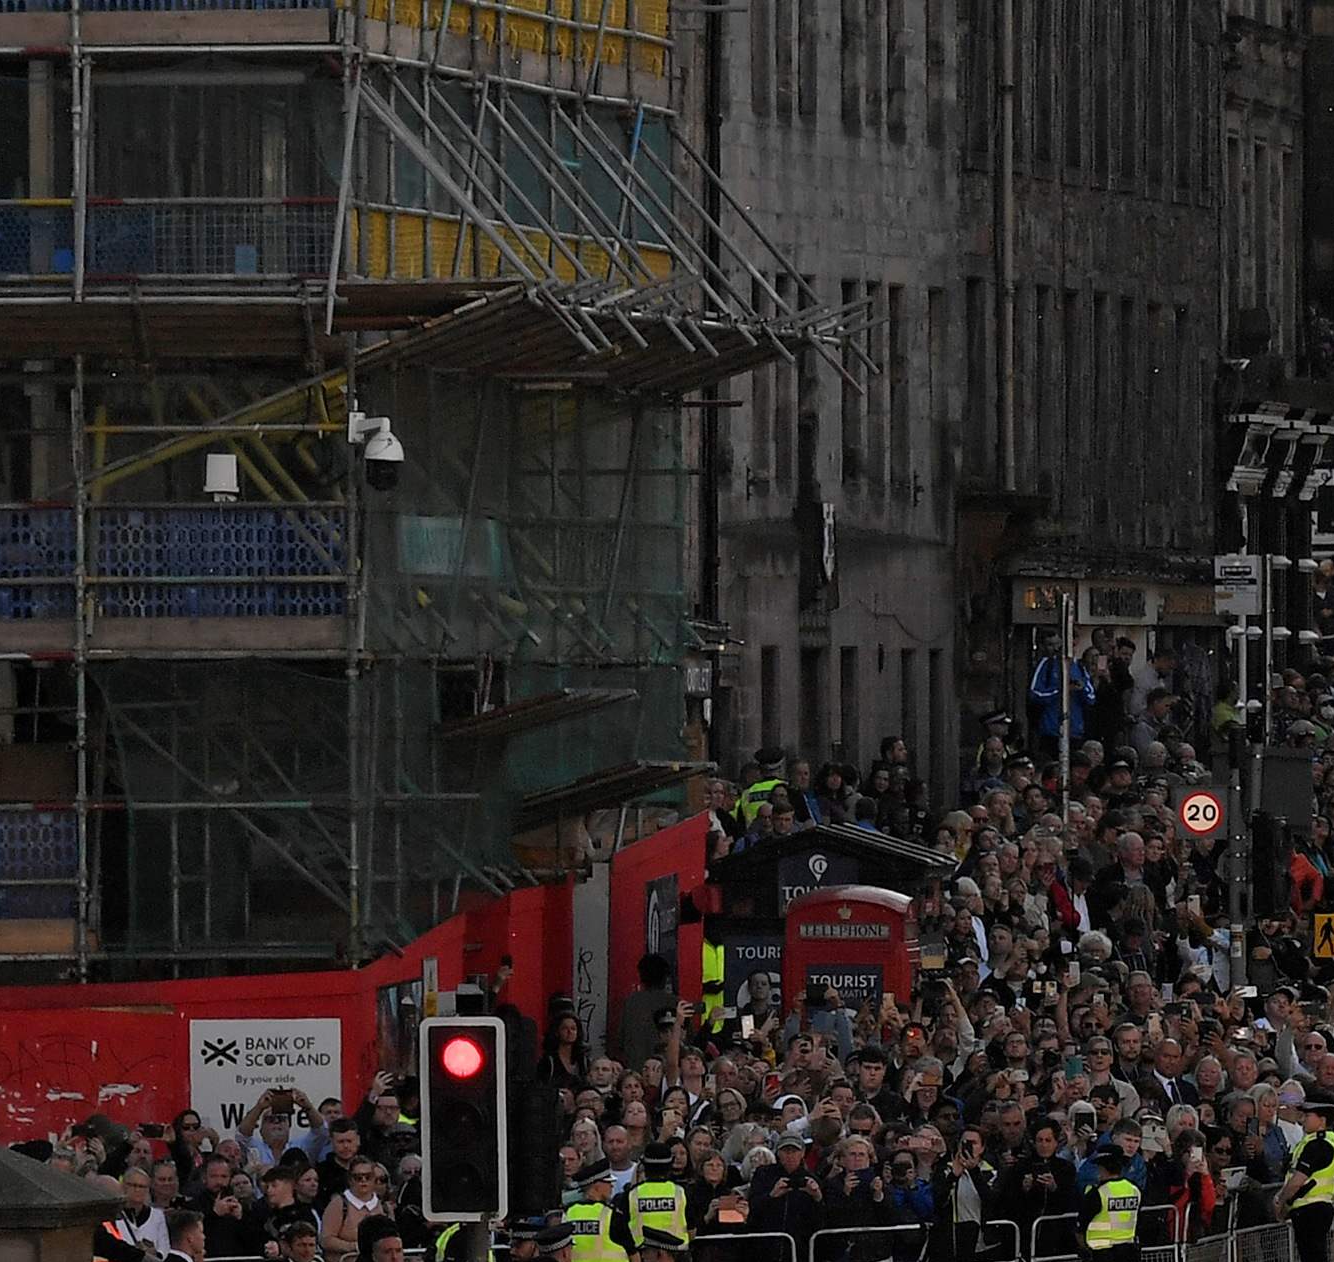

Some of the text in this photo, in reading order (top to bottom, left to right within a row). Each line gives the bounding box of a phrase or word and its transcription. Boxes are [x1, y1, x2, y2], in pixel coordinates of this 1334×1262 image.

[1187, 804, 1216, 822] 20
[805, 926, 883, 937] TELEPHONE
[736, 946, 781, 960] TOURI
[810, 974, 878, 988] TOURIST
[245, 1037, 316, 1050] BANK OF
[245, 1053, 331, 1067] SCOTLAND
[236, 1074, 296, 1085] By your side
[639, 1199, 674, 1211] POLICE
[1109, 1199, 1138, 1210] POLICE
[572, 1222, 598, 1233] OLICE
